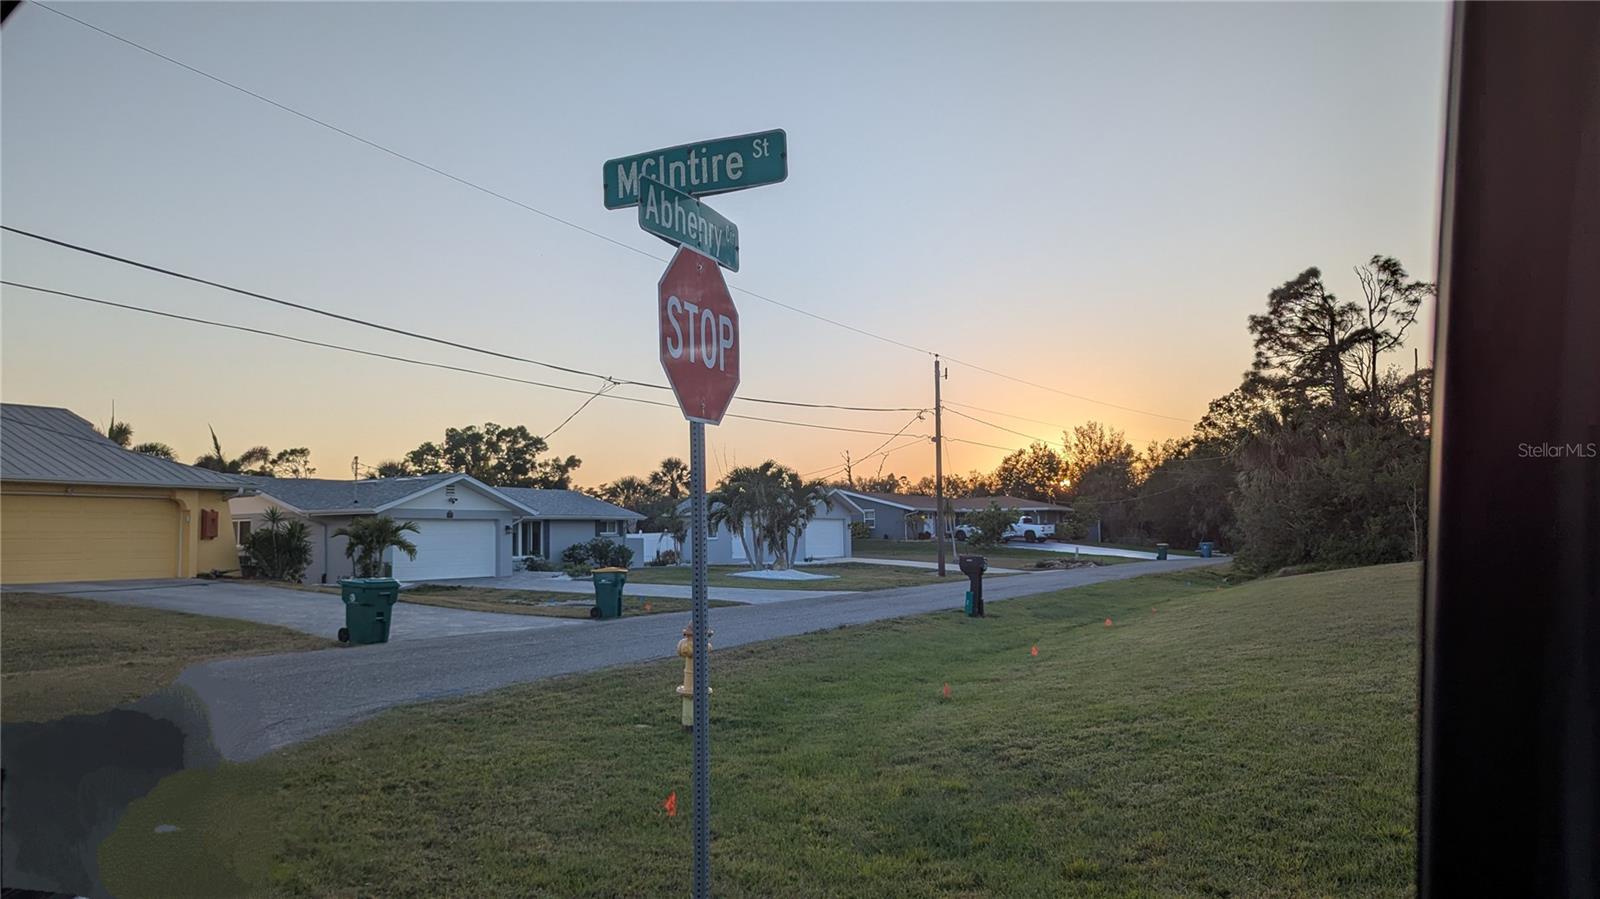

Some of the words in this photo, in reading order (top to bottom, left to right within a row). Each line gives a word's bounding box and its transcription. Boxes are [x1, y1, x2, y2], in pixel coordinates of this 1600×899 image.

[752, 138, 769, 158] St
[646, 185, 722, 257] Abhenry
[667, 296, 734, 371] STOP
